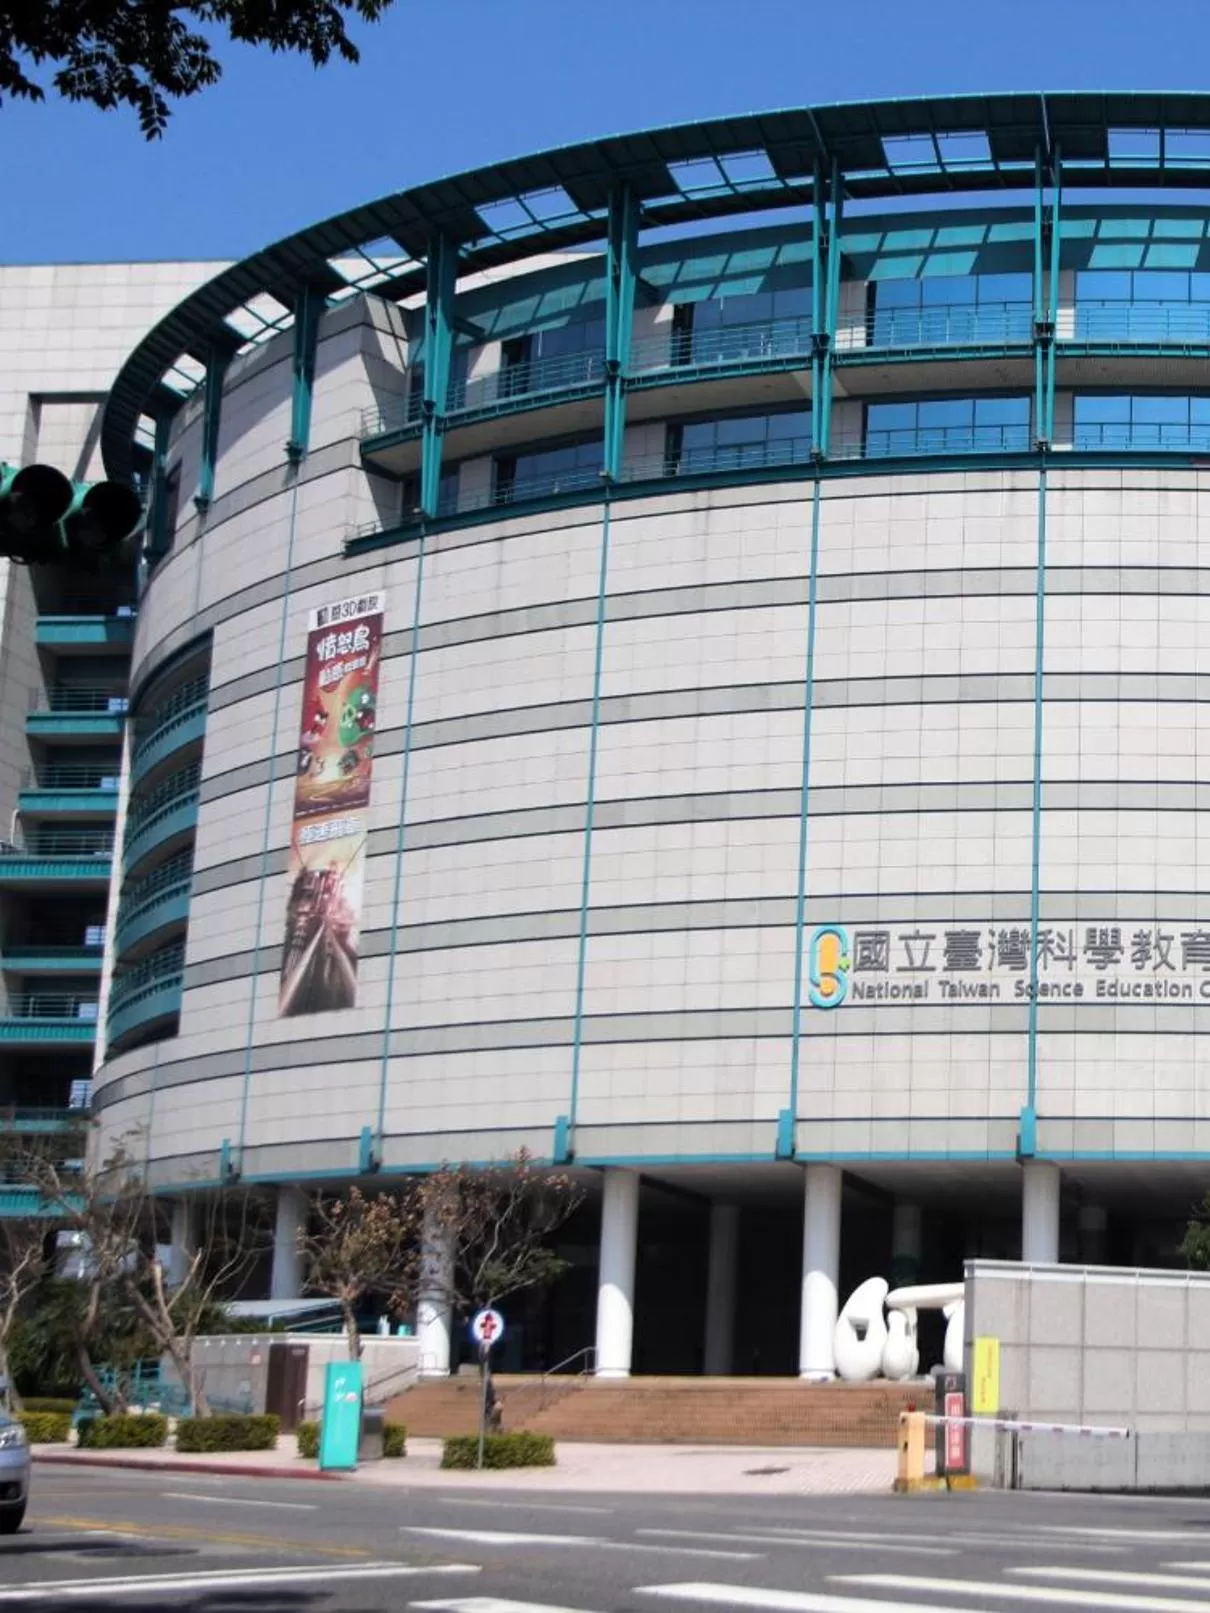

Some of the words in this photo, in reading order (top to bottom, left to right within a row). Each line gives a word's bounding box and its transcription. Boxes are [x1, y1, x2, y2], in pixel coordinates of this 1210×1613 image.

[851, 981, 928, 1000] National
[938, 981, 1000, 998] Taiwan
[1096, 979, 1192, 998] Education
